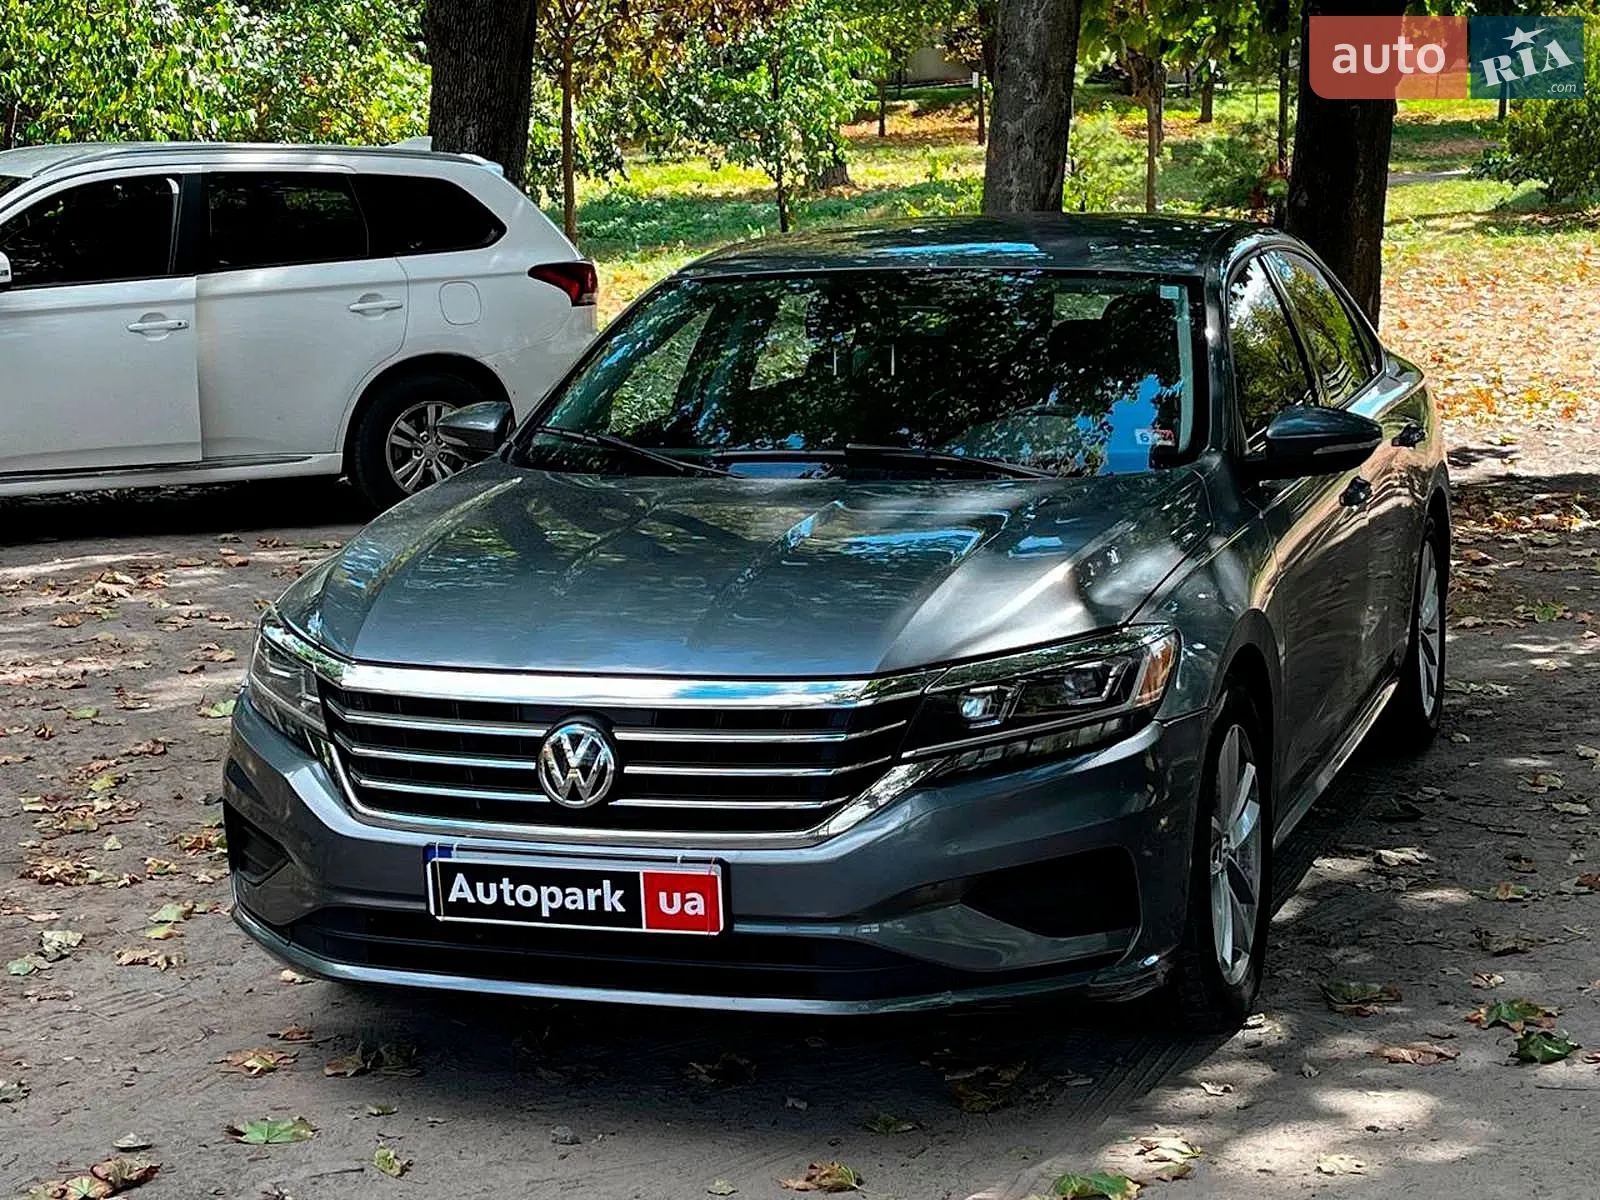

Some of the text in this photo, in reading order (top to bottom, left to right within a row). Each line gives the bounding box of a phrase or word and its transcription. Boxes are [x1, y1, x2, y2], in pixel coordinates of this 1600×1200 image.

[539, 724, 614, 808] VW
[448, 872, 705, 917] Autopark ua
